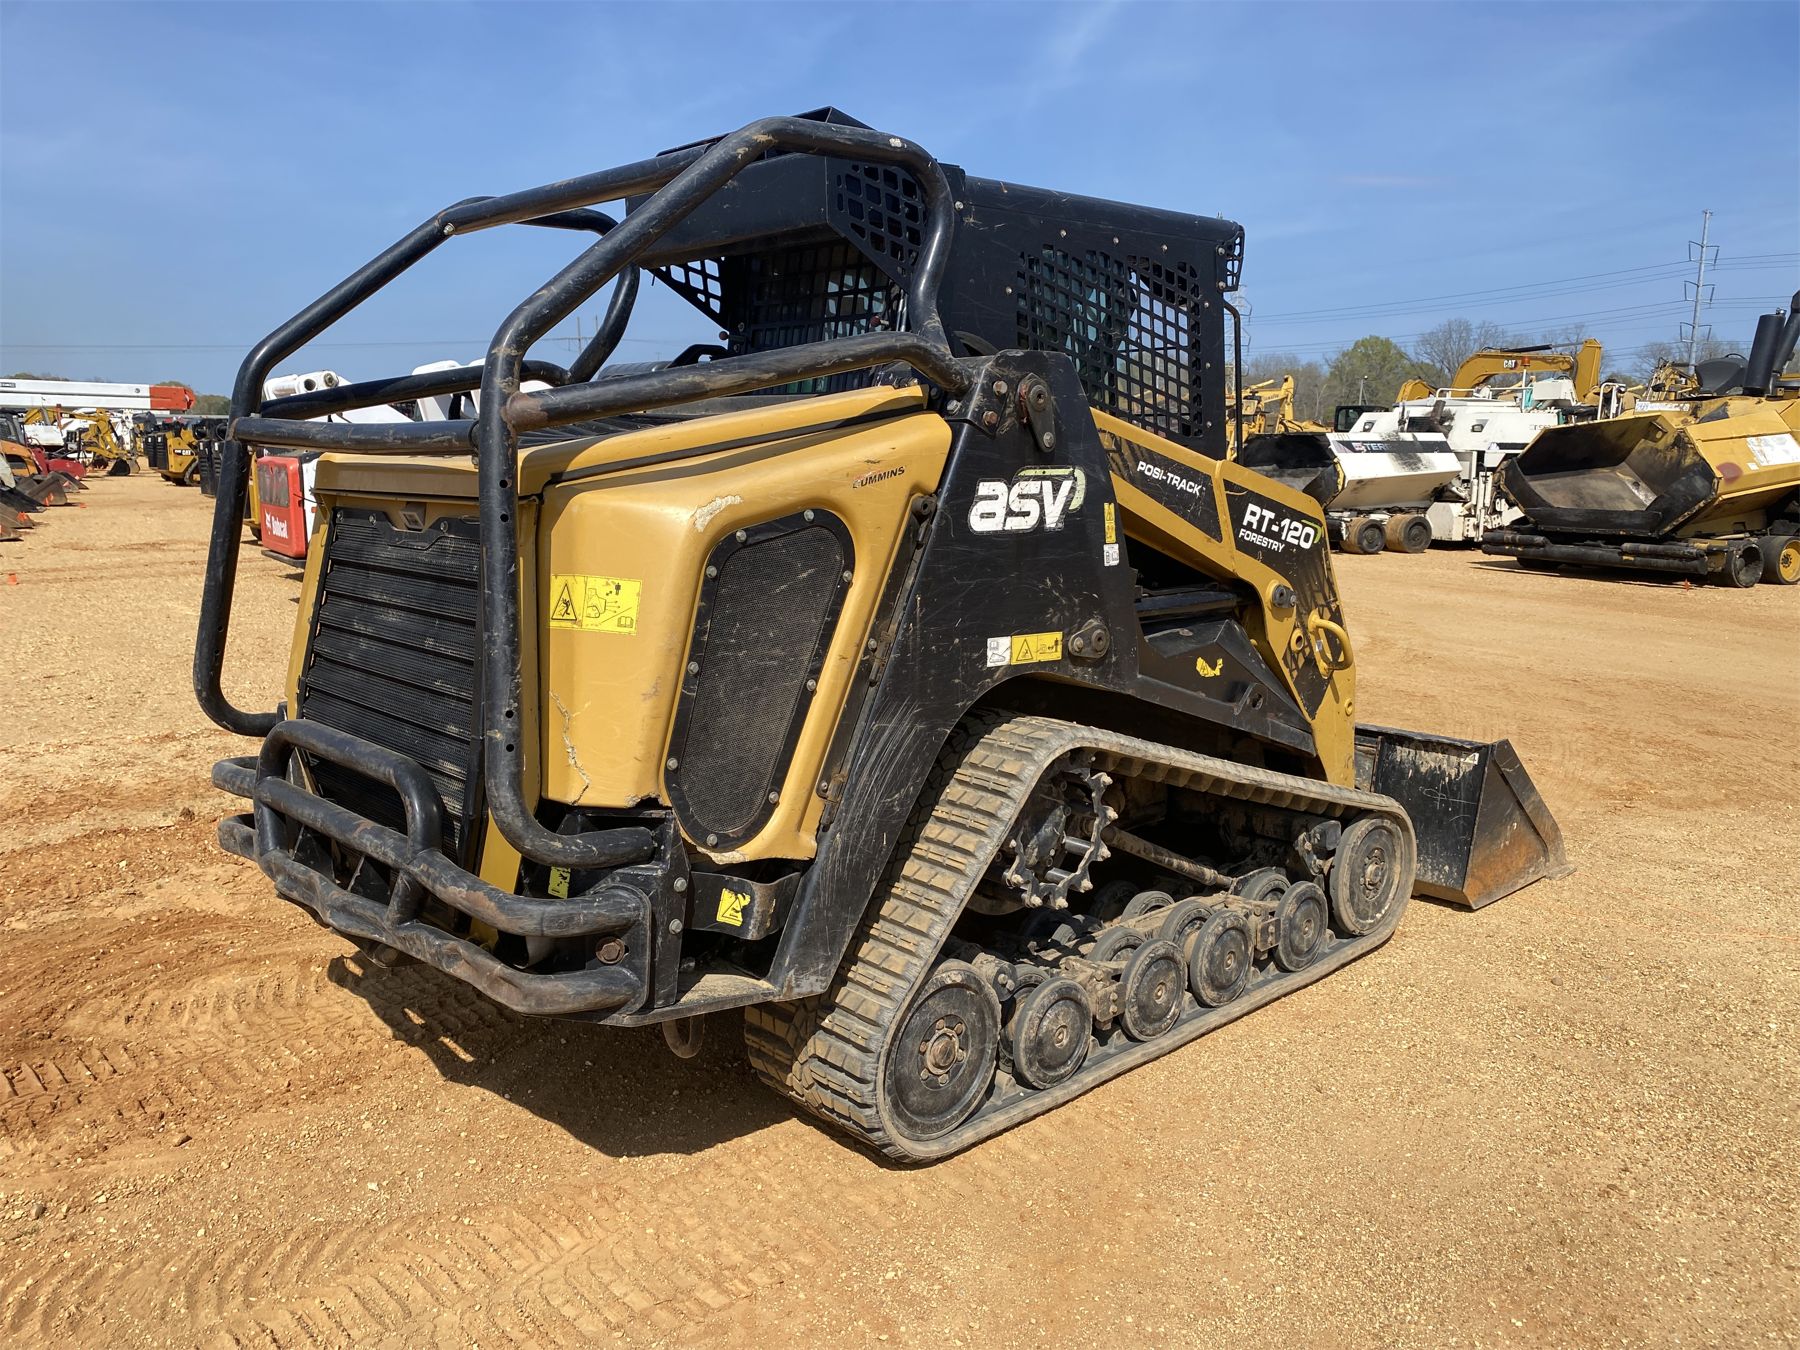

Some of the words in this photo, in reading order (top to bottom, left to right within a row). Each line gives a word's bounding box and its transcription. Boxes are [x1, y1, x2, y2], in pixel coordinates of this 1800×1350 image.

[1503, 359, 1516, 369] CAT
[1136, 460, 1202, 497] POSI-TRACK
[271, 515, 288, 539] Bobcat
[1242, 503, 1315, 550] RT-120
[1238, 528, 1285, 553] FORESTRY
